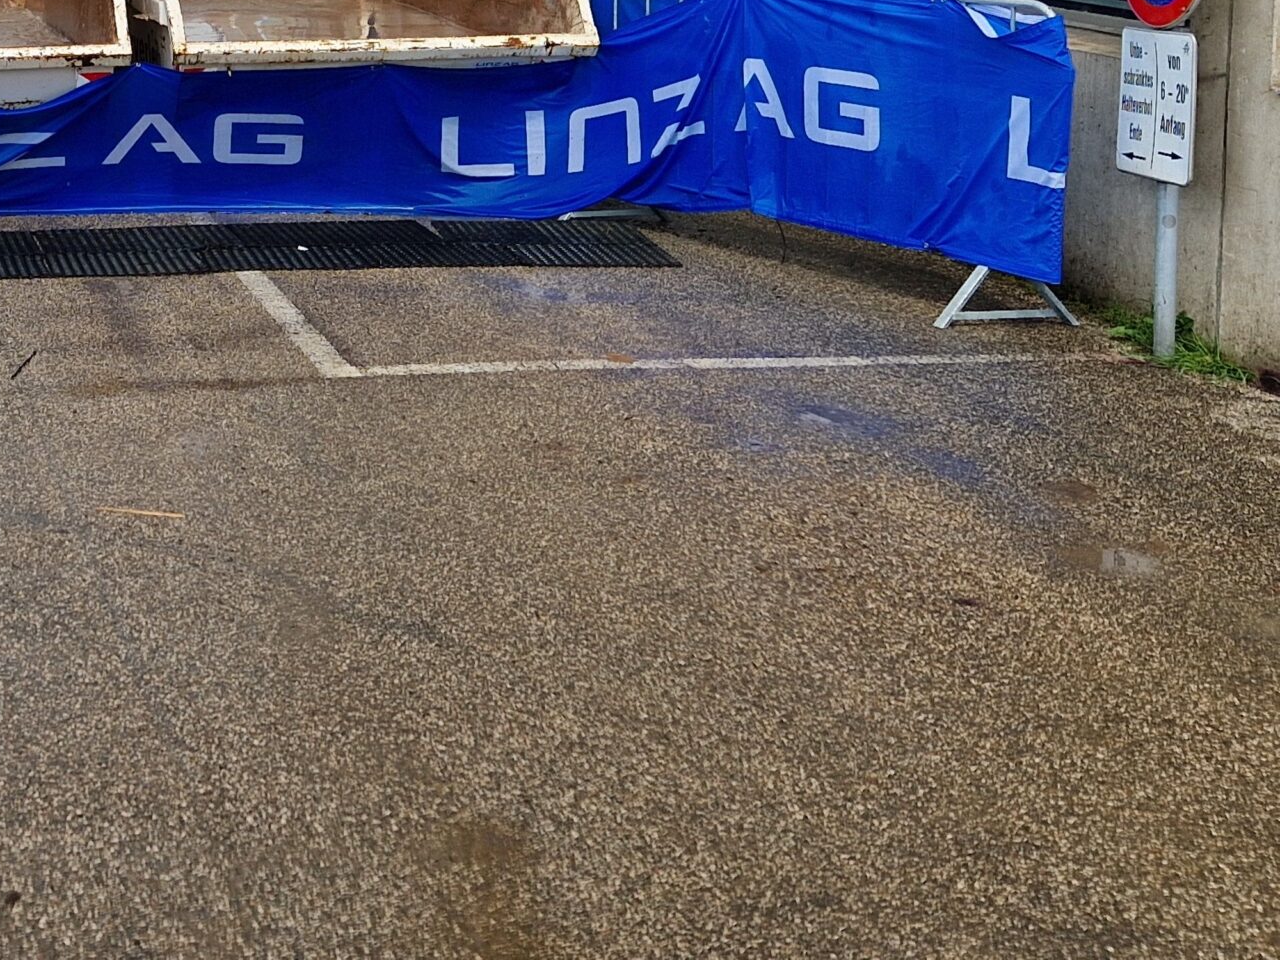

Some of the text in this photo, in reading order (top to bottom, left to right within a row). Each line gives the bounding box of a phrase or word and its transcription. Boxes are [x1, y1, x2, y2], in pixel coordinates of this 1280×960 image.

[1167, 54, 1181, 71] von
[1160, 80, 1166, 101] 6
[734, 57, 881, 153] AG
[102, 112, 305, 166] AG
[1129, 122, 1143, 142] Ende
[1159, 114, 1186, 141] Anfang
